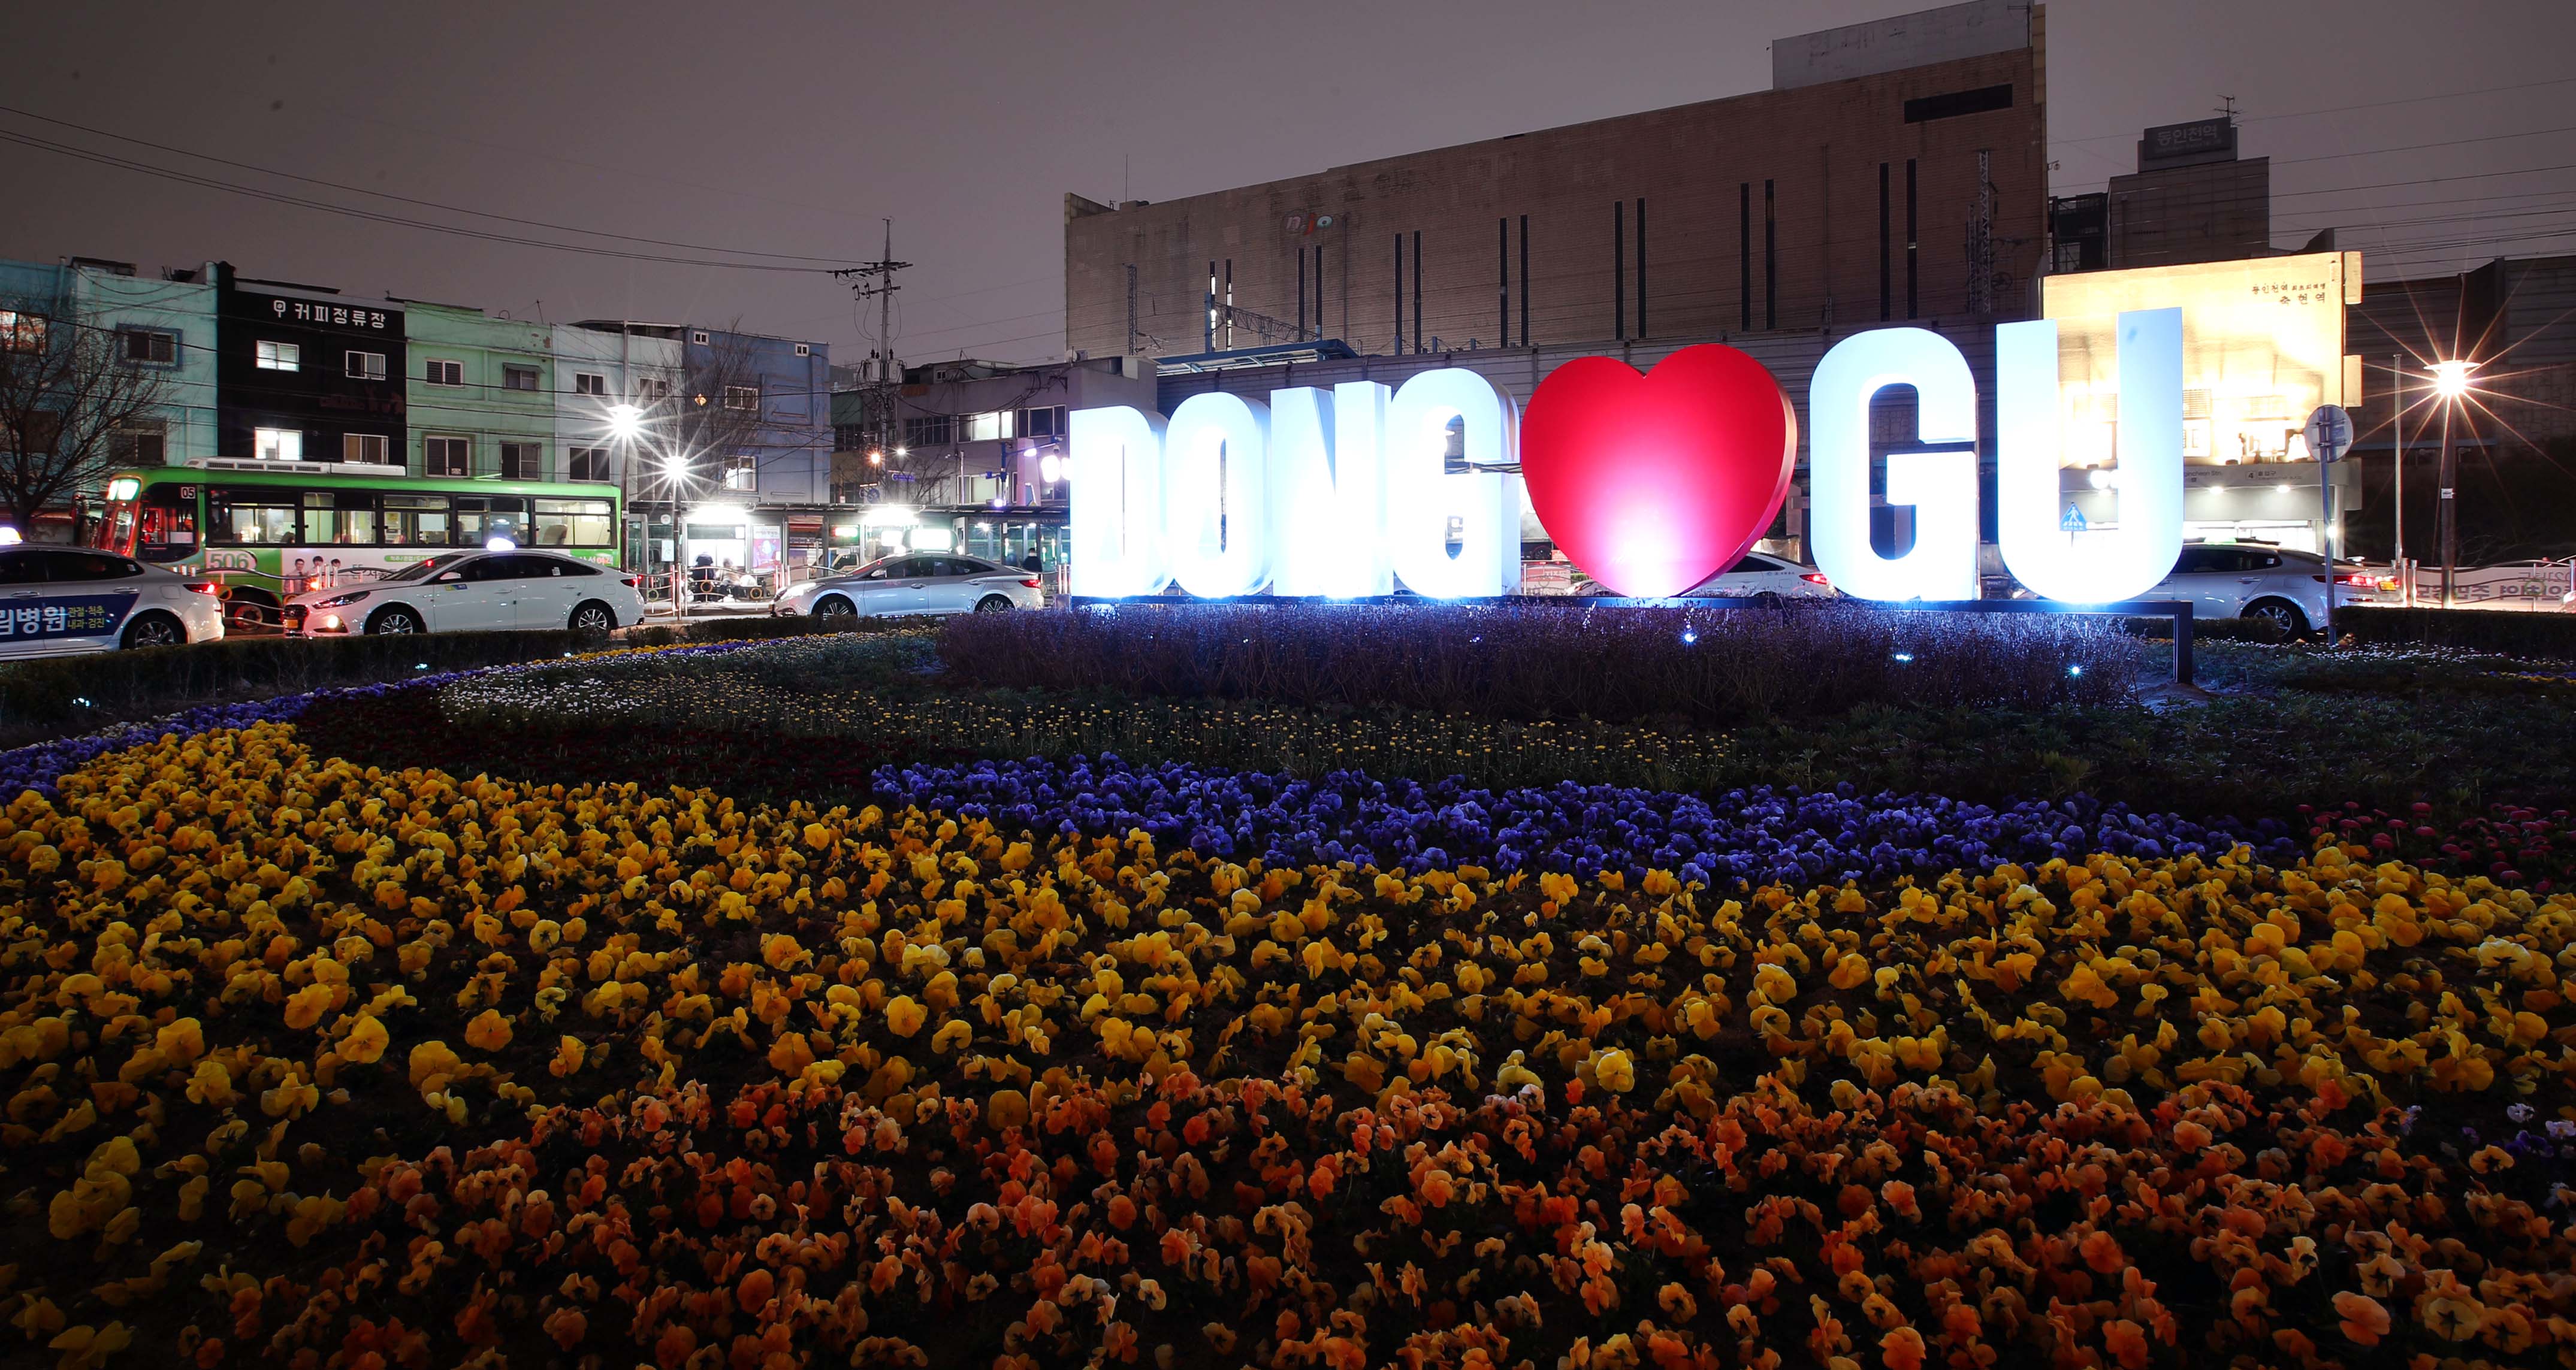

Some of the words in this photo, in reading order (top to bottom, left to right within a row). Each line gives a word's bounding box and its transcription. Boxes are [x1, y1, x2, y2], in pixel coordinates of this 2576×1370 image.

[2157, 125, 2217, 146] 동인천역
[294, 303, 386, 329] 커피정류장
[1069, 367, 1520, 600] DONG
[1809, 307, 2184, 604] GU
[182, 488, 195, 498] 05
[210, 553, 249, 569] 506
